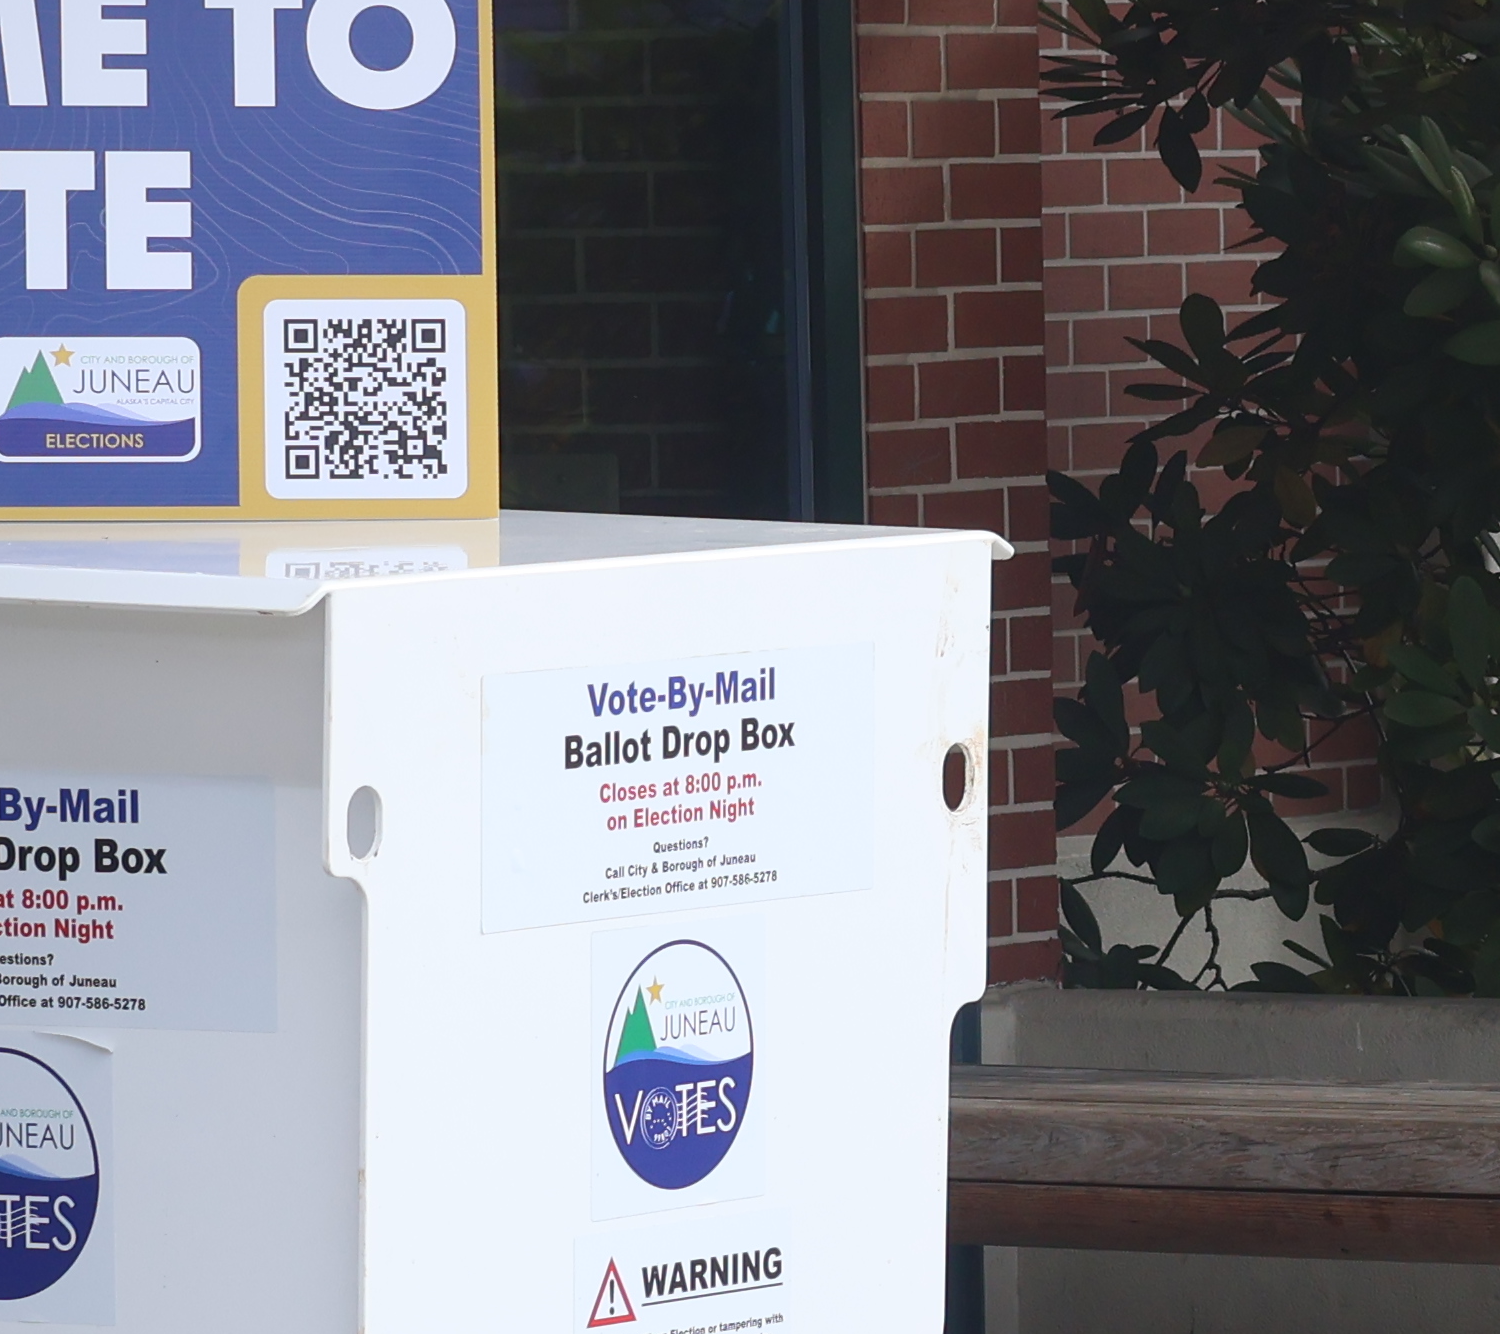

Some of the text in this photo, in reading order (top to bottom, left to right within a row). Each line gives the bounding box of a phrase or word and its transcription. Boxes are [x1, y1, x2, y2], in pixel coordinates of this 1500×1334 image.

[81, 356, 194, 364] CITY AND BOROUGH OF
[73, 369, 194, 393] JUNEAU
[46, 433, 144, 449] ELECTIONS
[588, 667, 775, 717] Vote-By-Mail
[565, 717, 795, 769] Ballot Drop Box
[600, 771, 762, 803] Closes 8:00 p.m.
[607, 797, 754, 831] on Election Night
[94, 839, 167, 874] Box
[653, 836, 708, 854] Questions?
[605, 852, 756, 880] Call City Borough Juneau
[583, 870, 777, 904] Clerk's/Election Office 907-586-5278
[21, 890, 69, 910] 8:00
[76, 894, 123, 914] p.m.
[54, 919, 114, 944] Night
[52, 974, 65, 987] of
[69, 975, 116, 988] Juneau
[41, 996, 53, 1008] at
[58, 996, 145, 1011] 907-586-5278
[660, 1006, 735, 1041] JUNEAU
[1, 1108, 17, 1117] AND
[20, 1109, 61, 1118] BOROUGH
[63, 1110, 73, 1119] OF
[615, 1077, 736, 1145] VOTES
[642, 1247, 782, 1298] WARNING
[719, 1317, 763, 1332] tampering
[765, 1313, 783, 1325] with
